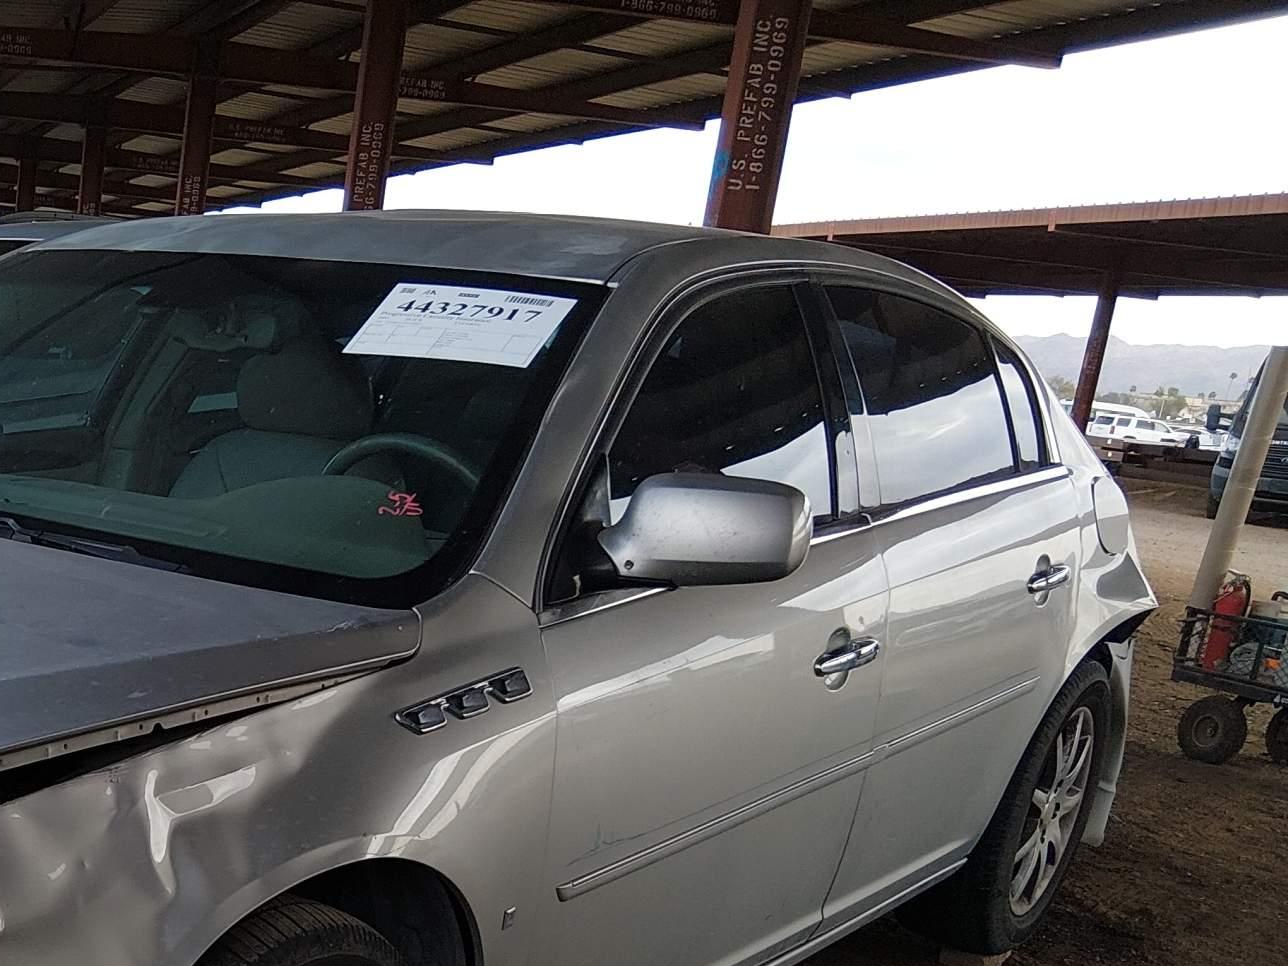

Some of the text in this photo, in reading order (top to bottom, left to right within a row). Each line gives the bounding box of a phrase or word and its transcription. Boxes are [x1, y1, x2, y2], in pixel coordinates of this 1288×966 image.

[353, 121, 373, 202] PREFAB INC.
[728, 14, 773, 190] U.S. PREFAB INC.
[745, 17, 789, 190] 1-866-799-0969
[397, 299, 543, 323] 44327917
